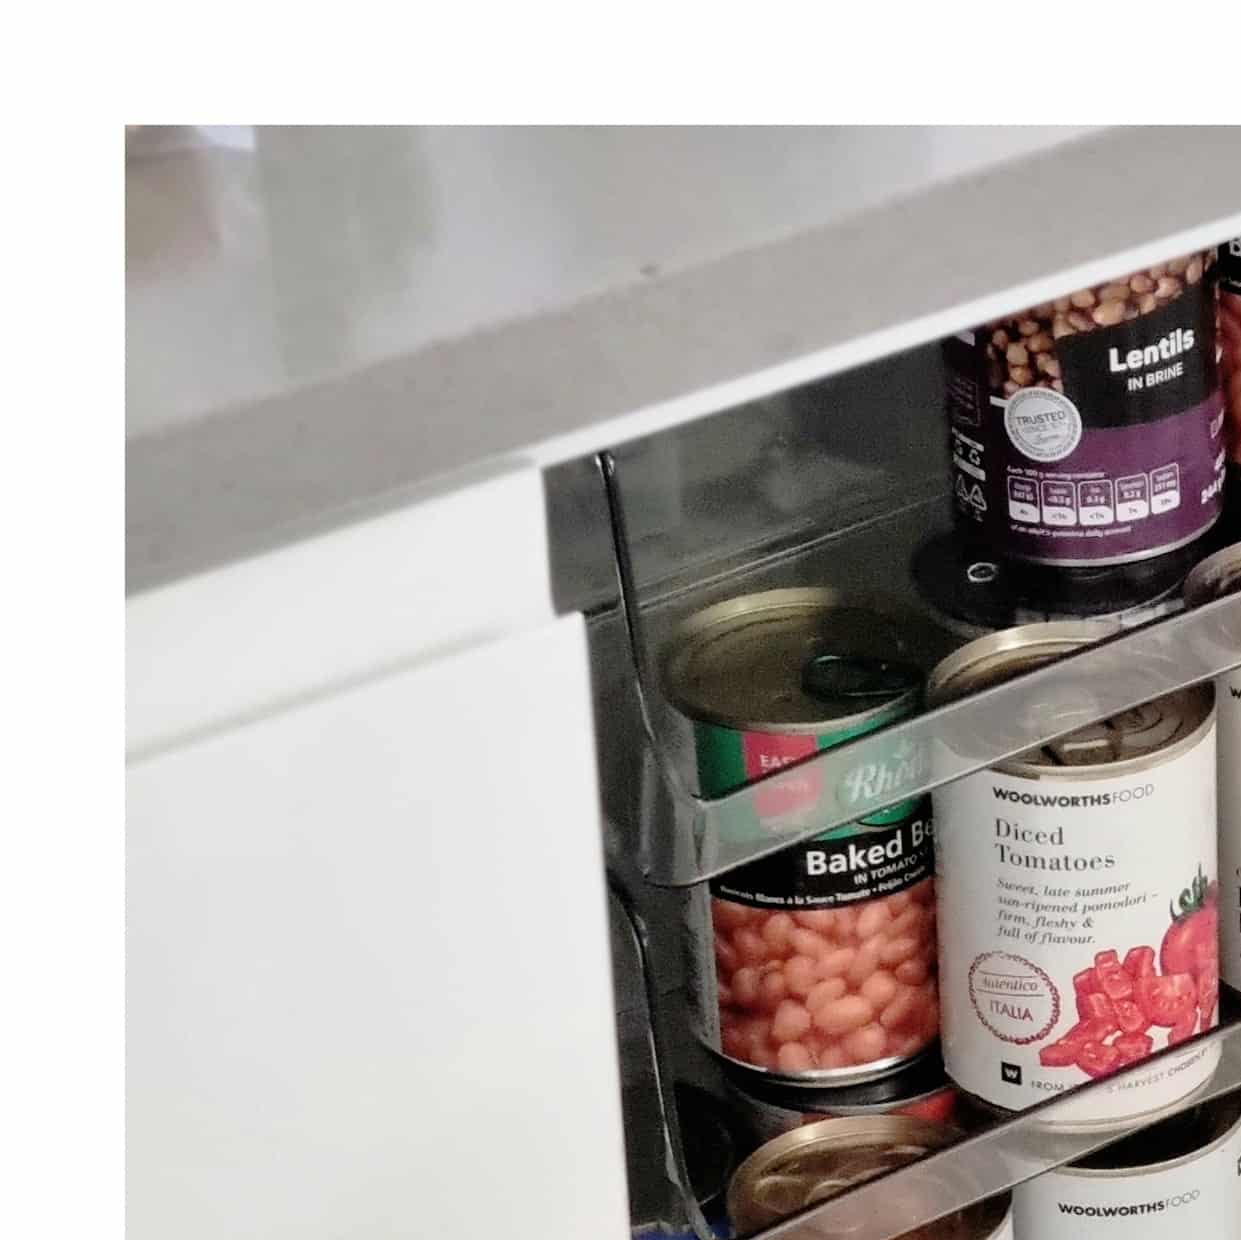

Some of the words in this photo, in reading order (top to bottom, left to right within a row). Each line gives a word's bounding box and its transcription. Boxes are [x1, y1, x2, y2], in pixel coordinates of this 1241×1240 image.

[1109, 328, 1195, 372] Lentils
[1128, 376, 1143, 391] IN
[1146, 362, 1184, 387] BRINE
[1016, 411, 1065, 425] TRUSTED
[992, 784, 1154, 807] WOOLWORTHSFOOD
[995, 818, 1064, 846] Diced
[807, 830, 902, 876] Baked
[994, 844, 1116, 871] Tomatoes
[854, 872, 868, 885] IN
[870, 854, 917, 880] TOMATO
[997, 878, 1039, 896] Sweet,
[1044, 885, 1070, 897] late
[1075, 881, 1131, 897] summer
[998, 896, 1078, 912] sun-ripened
[1082, 892, 1146, 914] pomodori
[998, 910, 1030, 926] firm,
[1033, 916, 1076, 931] fleshy
[1082, 917, 1094, 928] &
[997, 927, 1020, 940] full
[1024, 931, 1039, 944] of
[1040, 932, 1096, 945] flavour.
[990, 1000, 1034, 1022] ITALIA
[1058, 1189, 1200, 1217] WOOLWORTHSFOOD
